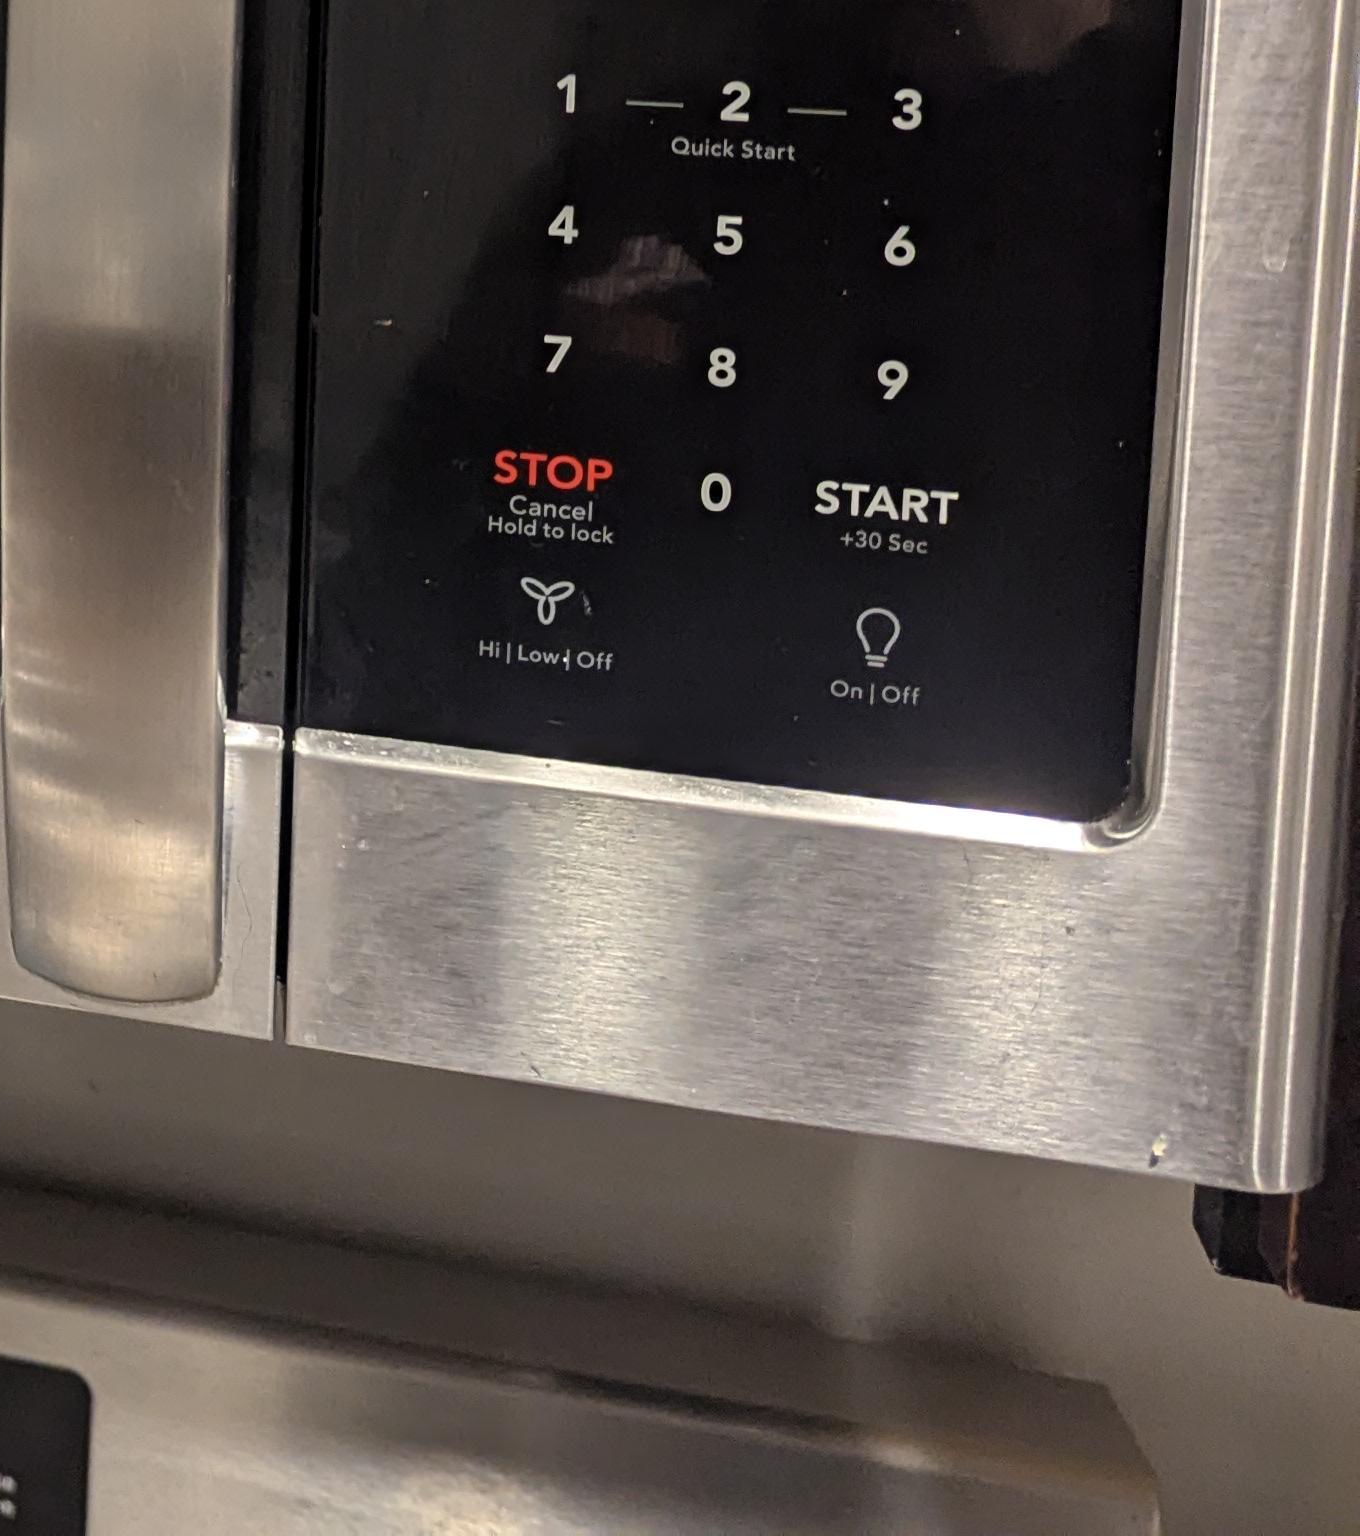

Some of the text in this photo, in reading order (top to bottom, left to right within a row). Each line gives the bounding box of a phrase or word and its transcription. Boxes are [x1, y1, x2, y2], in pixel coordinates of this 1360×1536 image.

[556, 73, 577, 114] 1
[720, 80, 751, 123] 2
[891, 88, 923, 131] 3
[671, 136, 795, 162] Quick Start
[547, 205, 579, 245] 4
[713, 214, 743, 256] 5
[884, 225, 916, 267] 6
[543, 334, 573, 373] 7
[707, 347, 737, 388] 8
[877, 359, 909, 401] 9
[493, 449, 614, 492] STOP
[509, 495, 593, 522] Cancel
[700, 472, 732, 512] 0
[814, 480, 960, 525] START
[488, 515, 614, 545] Hold to lock
[840, 529, 928, 554] +30 Sec
[478, 639, 500, 659] Hi
[517, 644, 560, 665] Low
[576, 650, 614, 671] Off
[830, 679, 863, 700] On
[881, 685, 920, 706] Off
